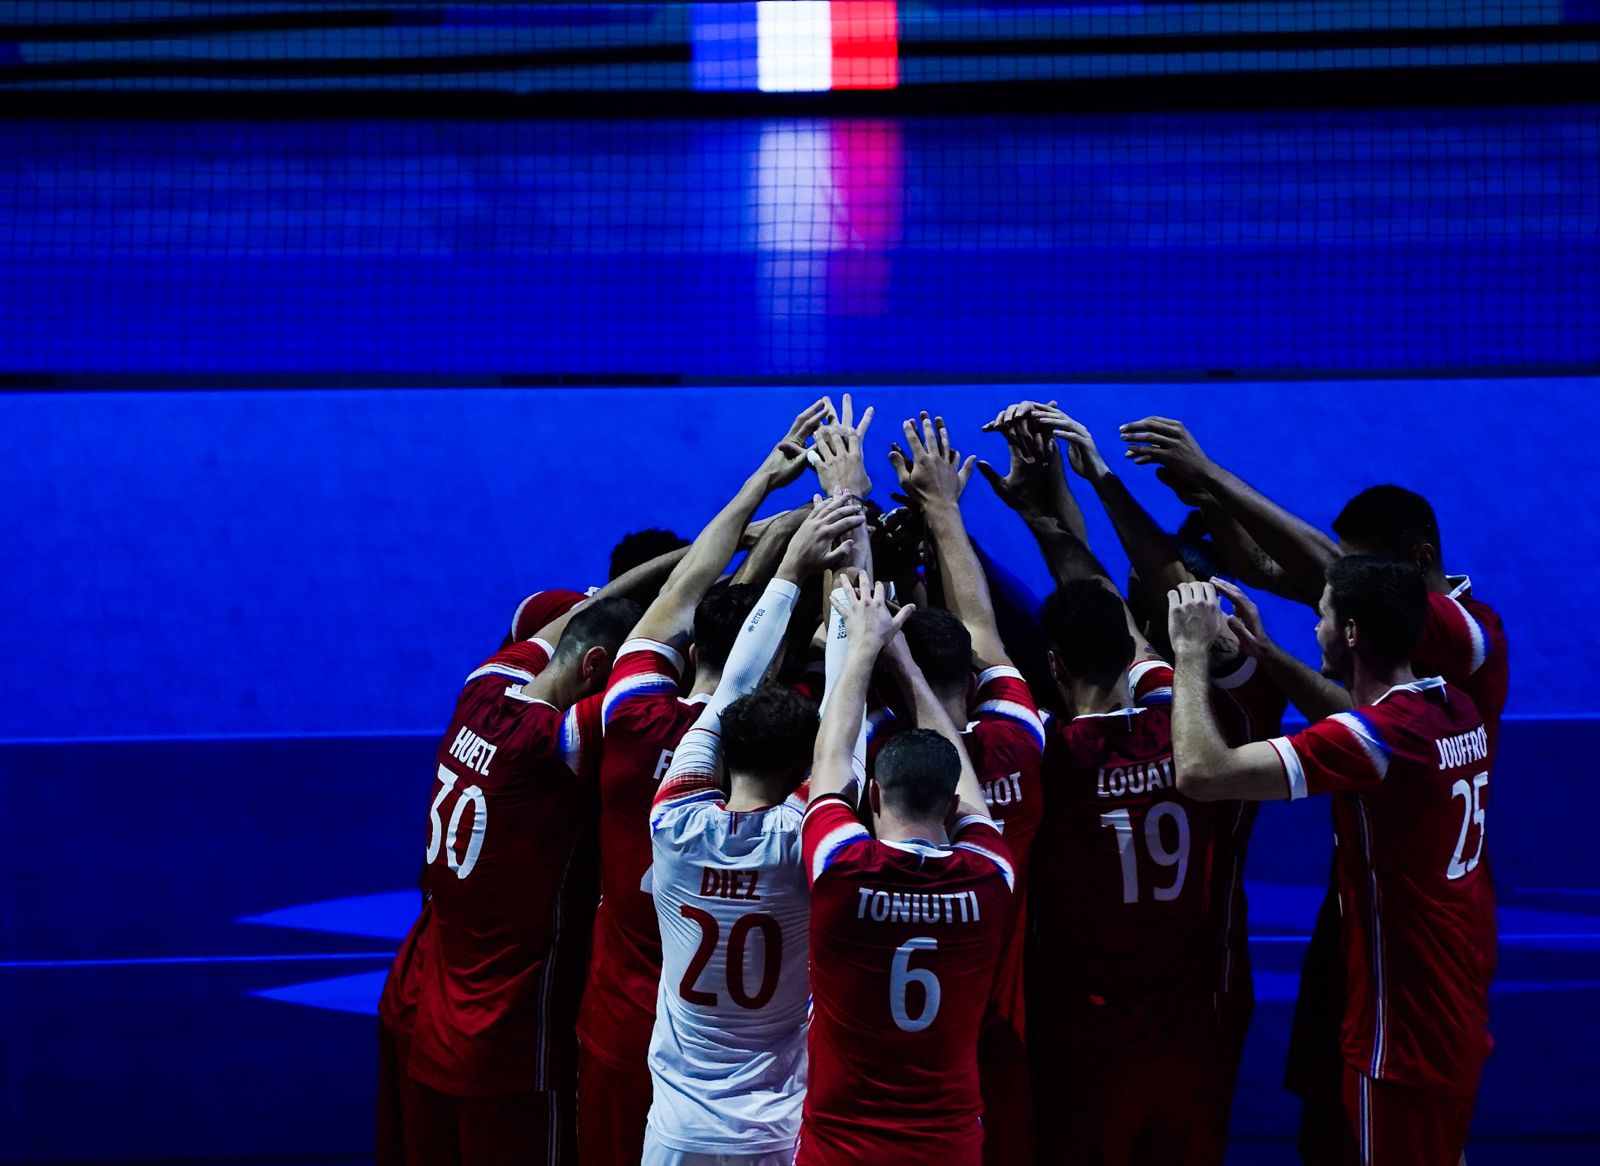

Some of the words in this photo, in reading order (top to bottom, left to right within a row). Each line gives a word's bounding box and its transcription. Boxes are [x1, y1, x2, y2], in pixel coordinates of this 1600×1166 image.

[449, 726, 497, 776] HUETZ
[1098, 757, 1173, 798] LOUAT
[1435, 724, 1487, 770] JOUFFRO
[427, 763, 487, 880] 30
[1100, 801, 1190, 904] 19
[1446, 771, 1488, 880] 25
[700, 866, 761, 901] DIEZ
[857, 887, 981, 924] TONIUTTI
[679, 904, 782, 1010] 20
[890, 937, 941, 1033] 6
